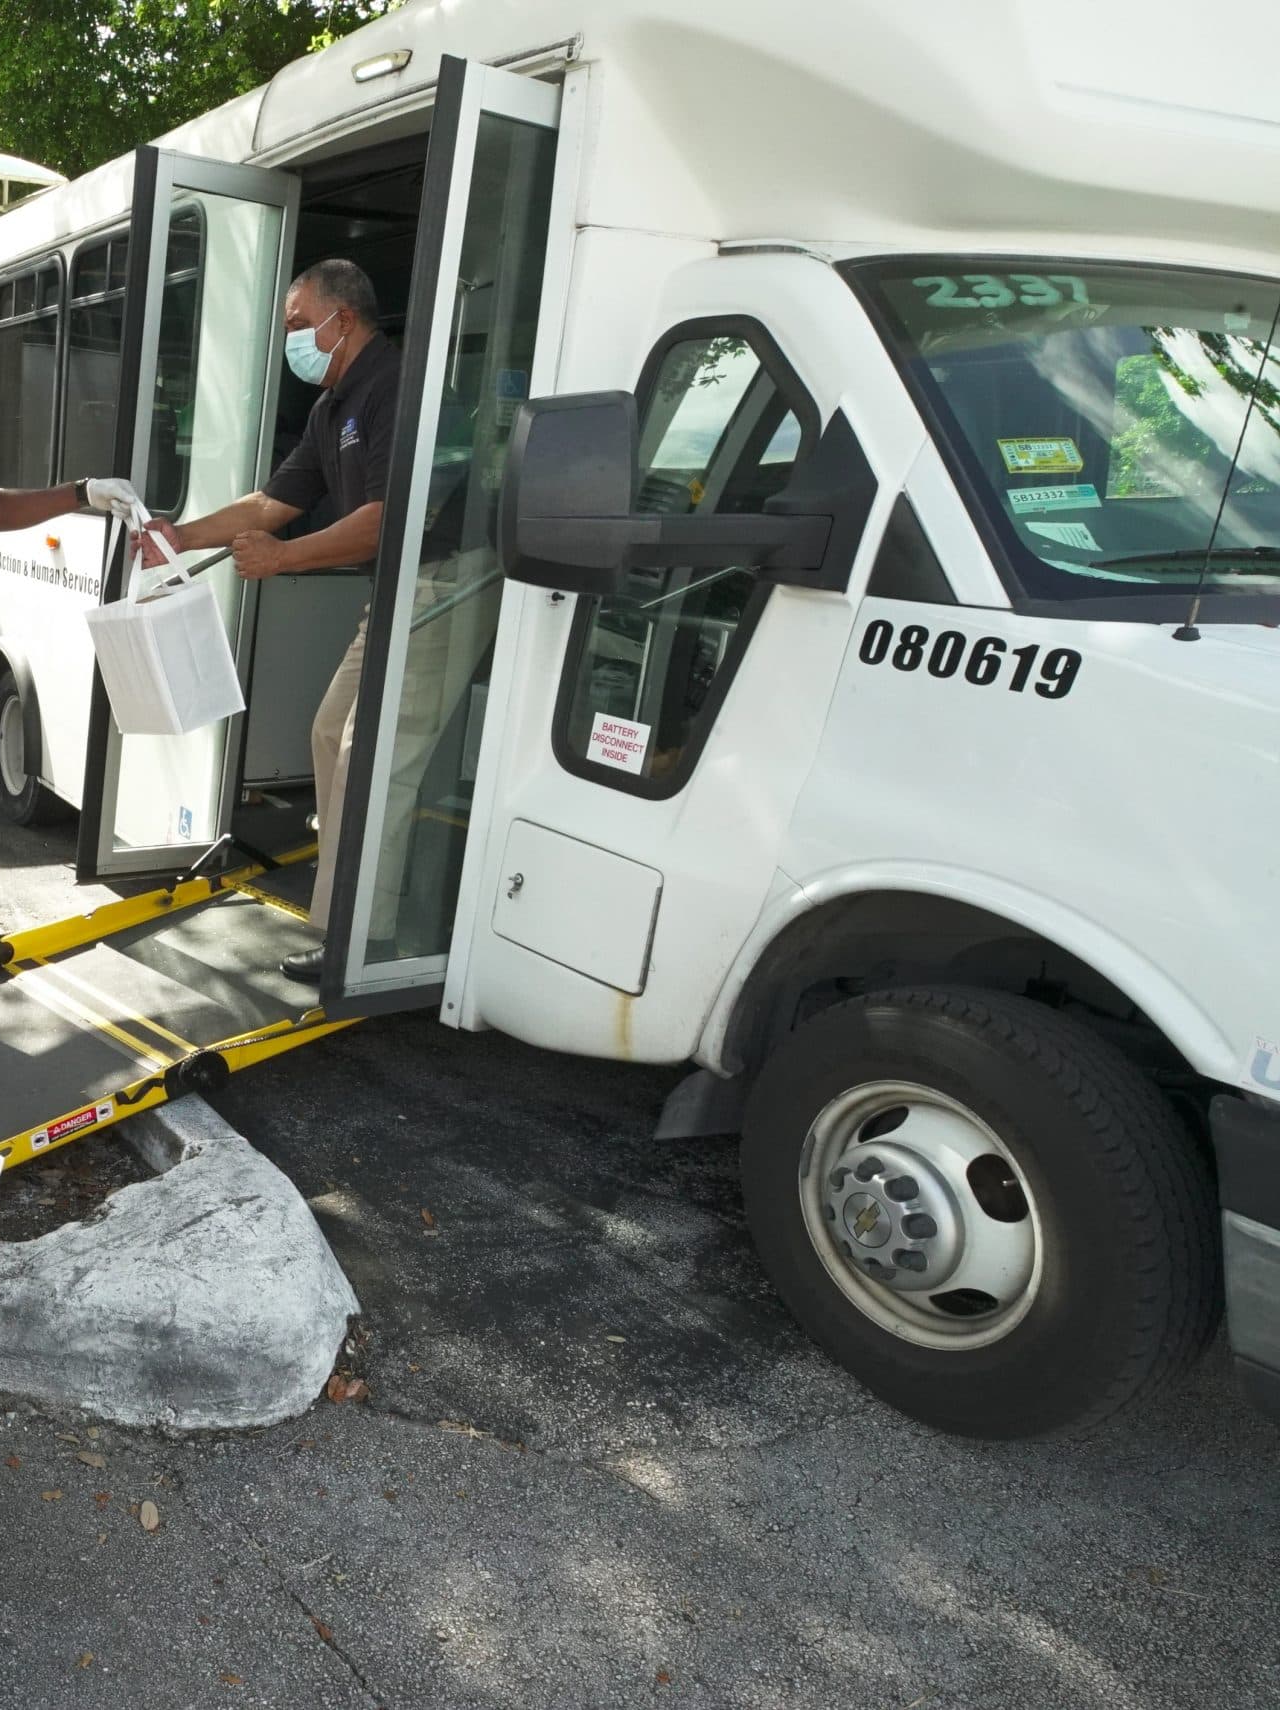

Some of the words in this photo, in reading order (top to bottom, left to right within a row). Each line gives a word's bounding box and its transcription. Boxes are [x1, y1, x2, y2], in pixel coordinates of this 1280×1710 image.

[912, 274, 1089, 308] 2337
[1013, 490, 1064, 503] SB12332
[23, 560, 29, 577] &
[31, 559, 60, 586] Human
[859, 619, 1082, 699] 080619
[602, 722, 639, 739] BATTERY
[592, 732, 644, 754] DISCONNECT
[601, 748, 628, 763] INSIDE
[60, 1111, 92, 1131] DANGER
